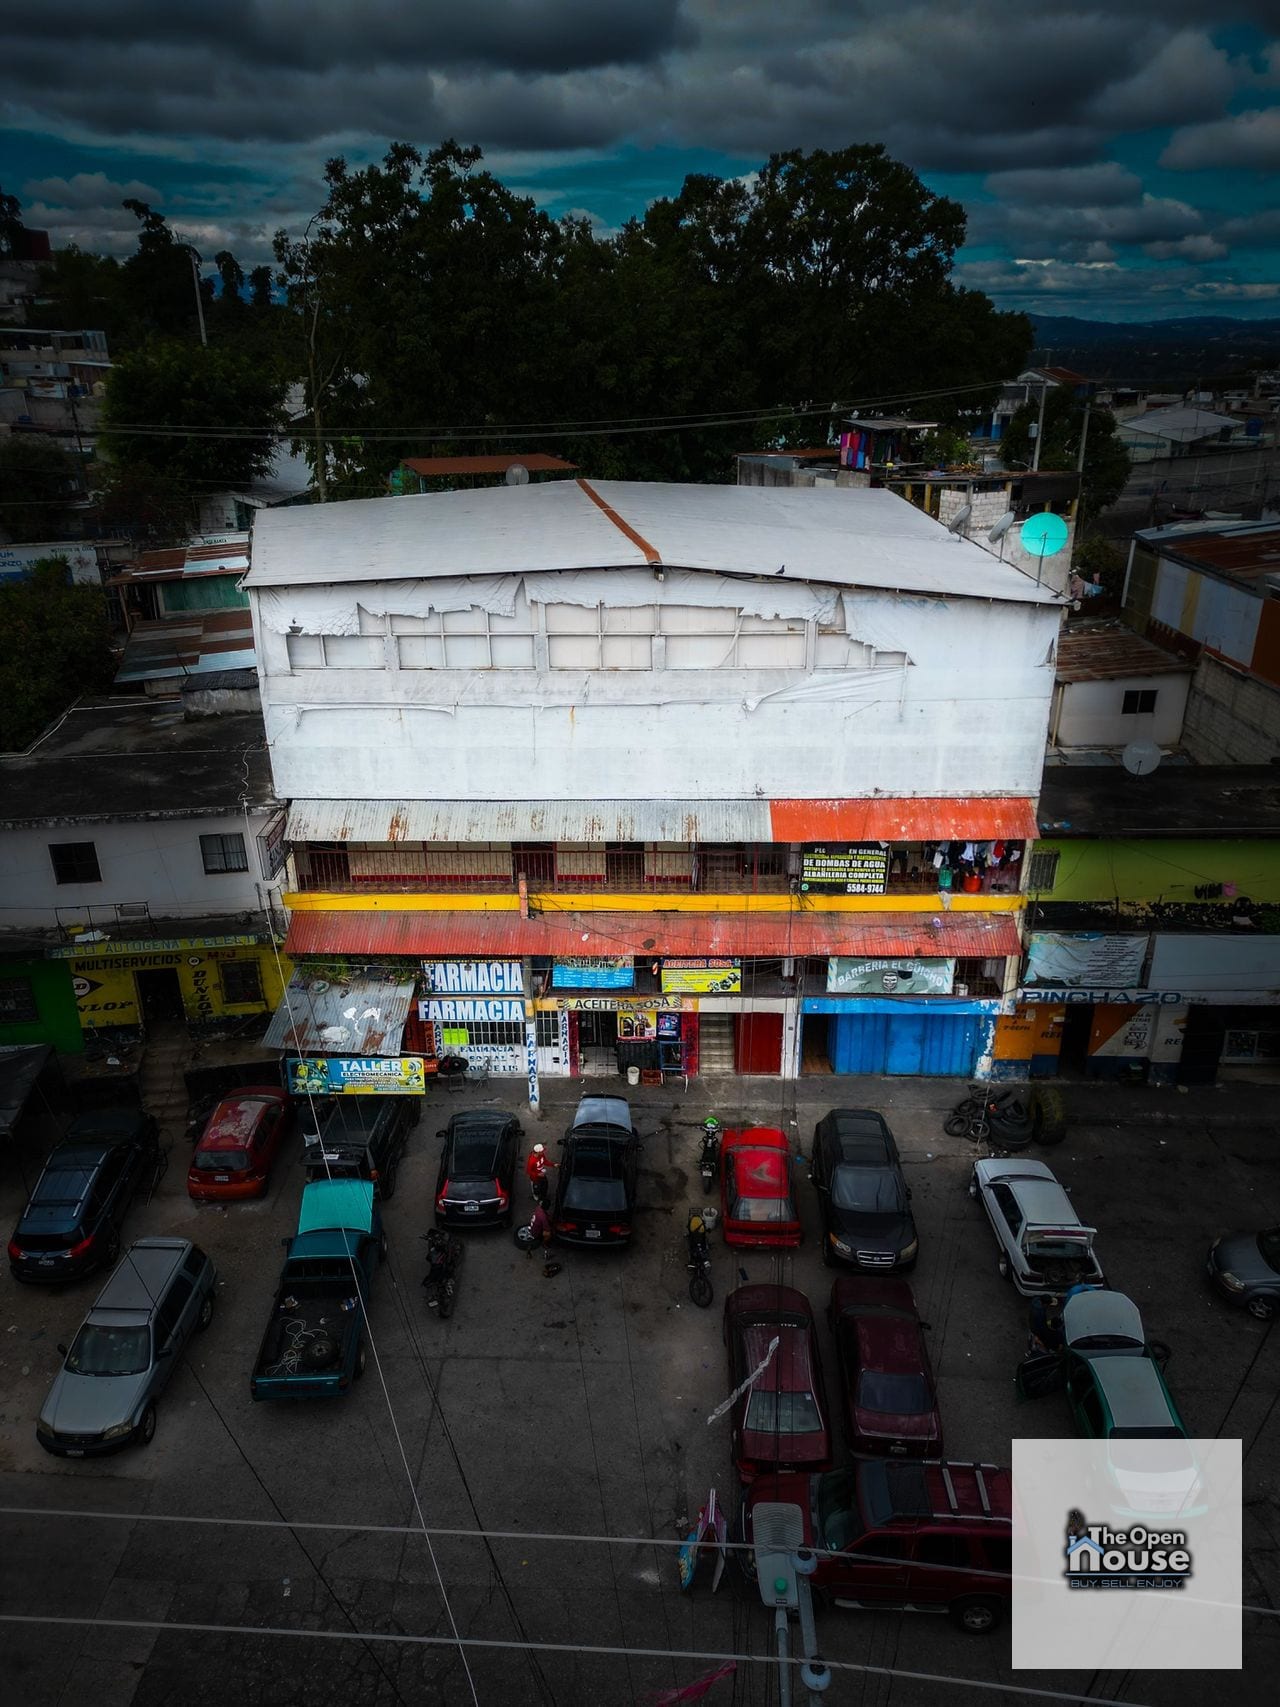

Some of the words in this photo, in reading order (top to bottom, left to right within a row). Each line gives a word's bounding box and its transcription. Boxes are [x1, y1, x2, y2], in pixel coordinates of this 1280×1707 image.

[803, 859, 815, 867] DE
[815, 859, 850, 868] BOMBAS
[851, 860, 863, 868] DE
[863, 861, 886, 869] AGUA
[846, 883, 884, 893] 5584-9744
[105, 938, 179, 953] AUTOGENA
[75, 954, 182, 972] MULTISERVICIOS
[662, 959, 707, 968] ACEITERA
[425, 962, 524, 992] FARMACIA
[837, 961, 889, 986] BARBERIA
[891, 961, 902, 969] EL
[575, 999, 634, 1010] ACEITERA
[637, 997, 670, 1009] SOSA
[1023, 991, 1181, 1005] PINCHAZO
[418, 1001, 525, 1020] FARMACIA
[340, 1060, 402, 1072] TALLER
[527, 1033, 538, 1102] FARMACIA
